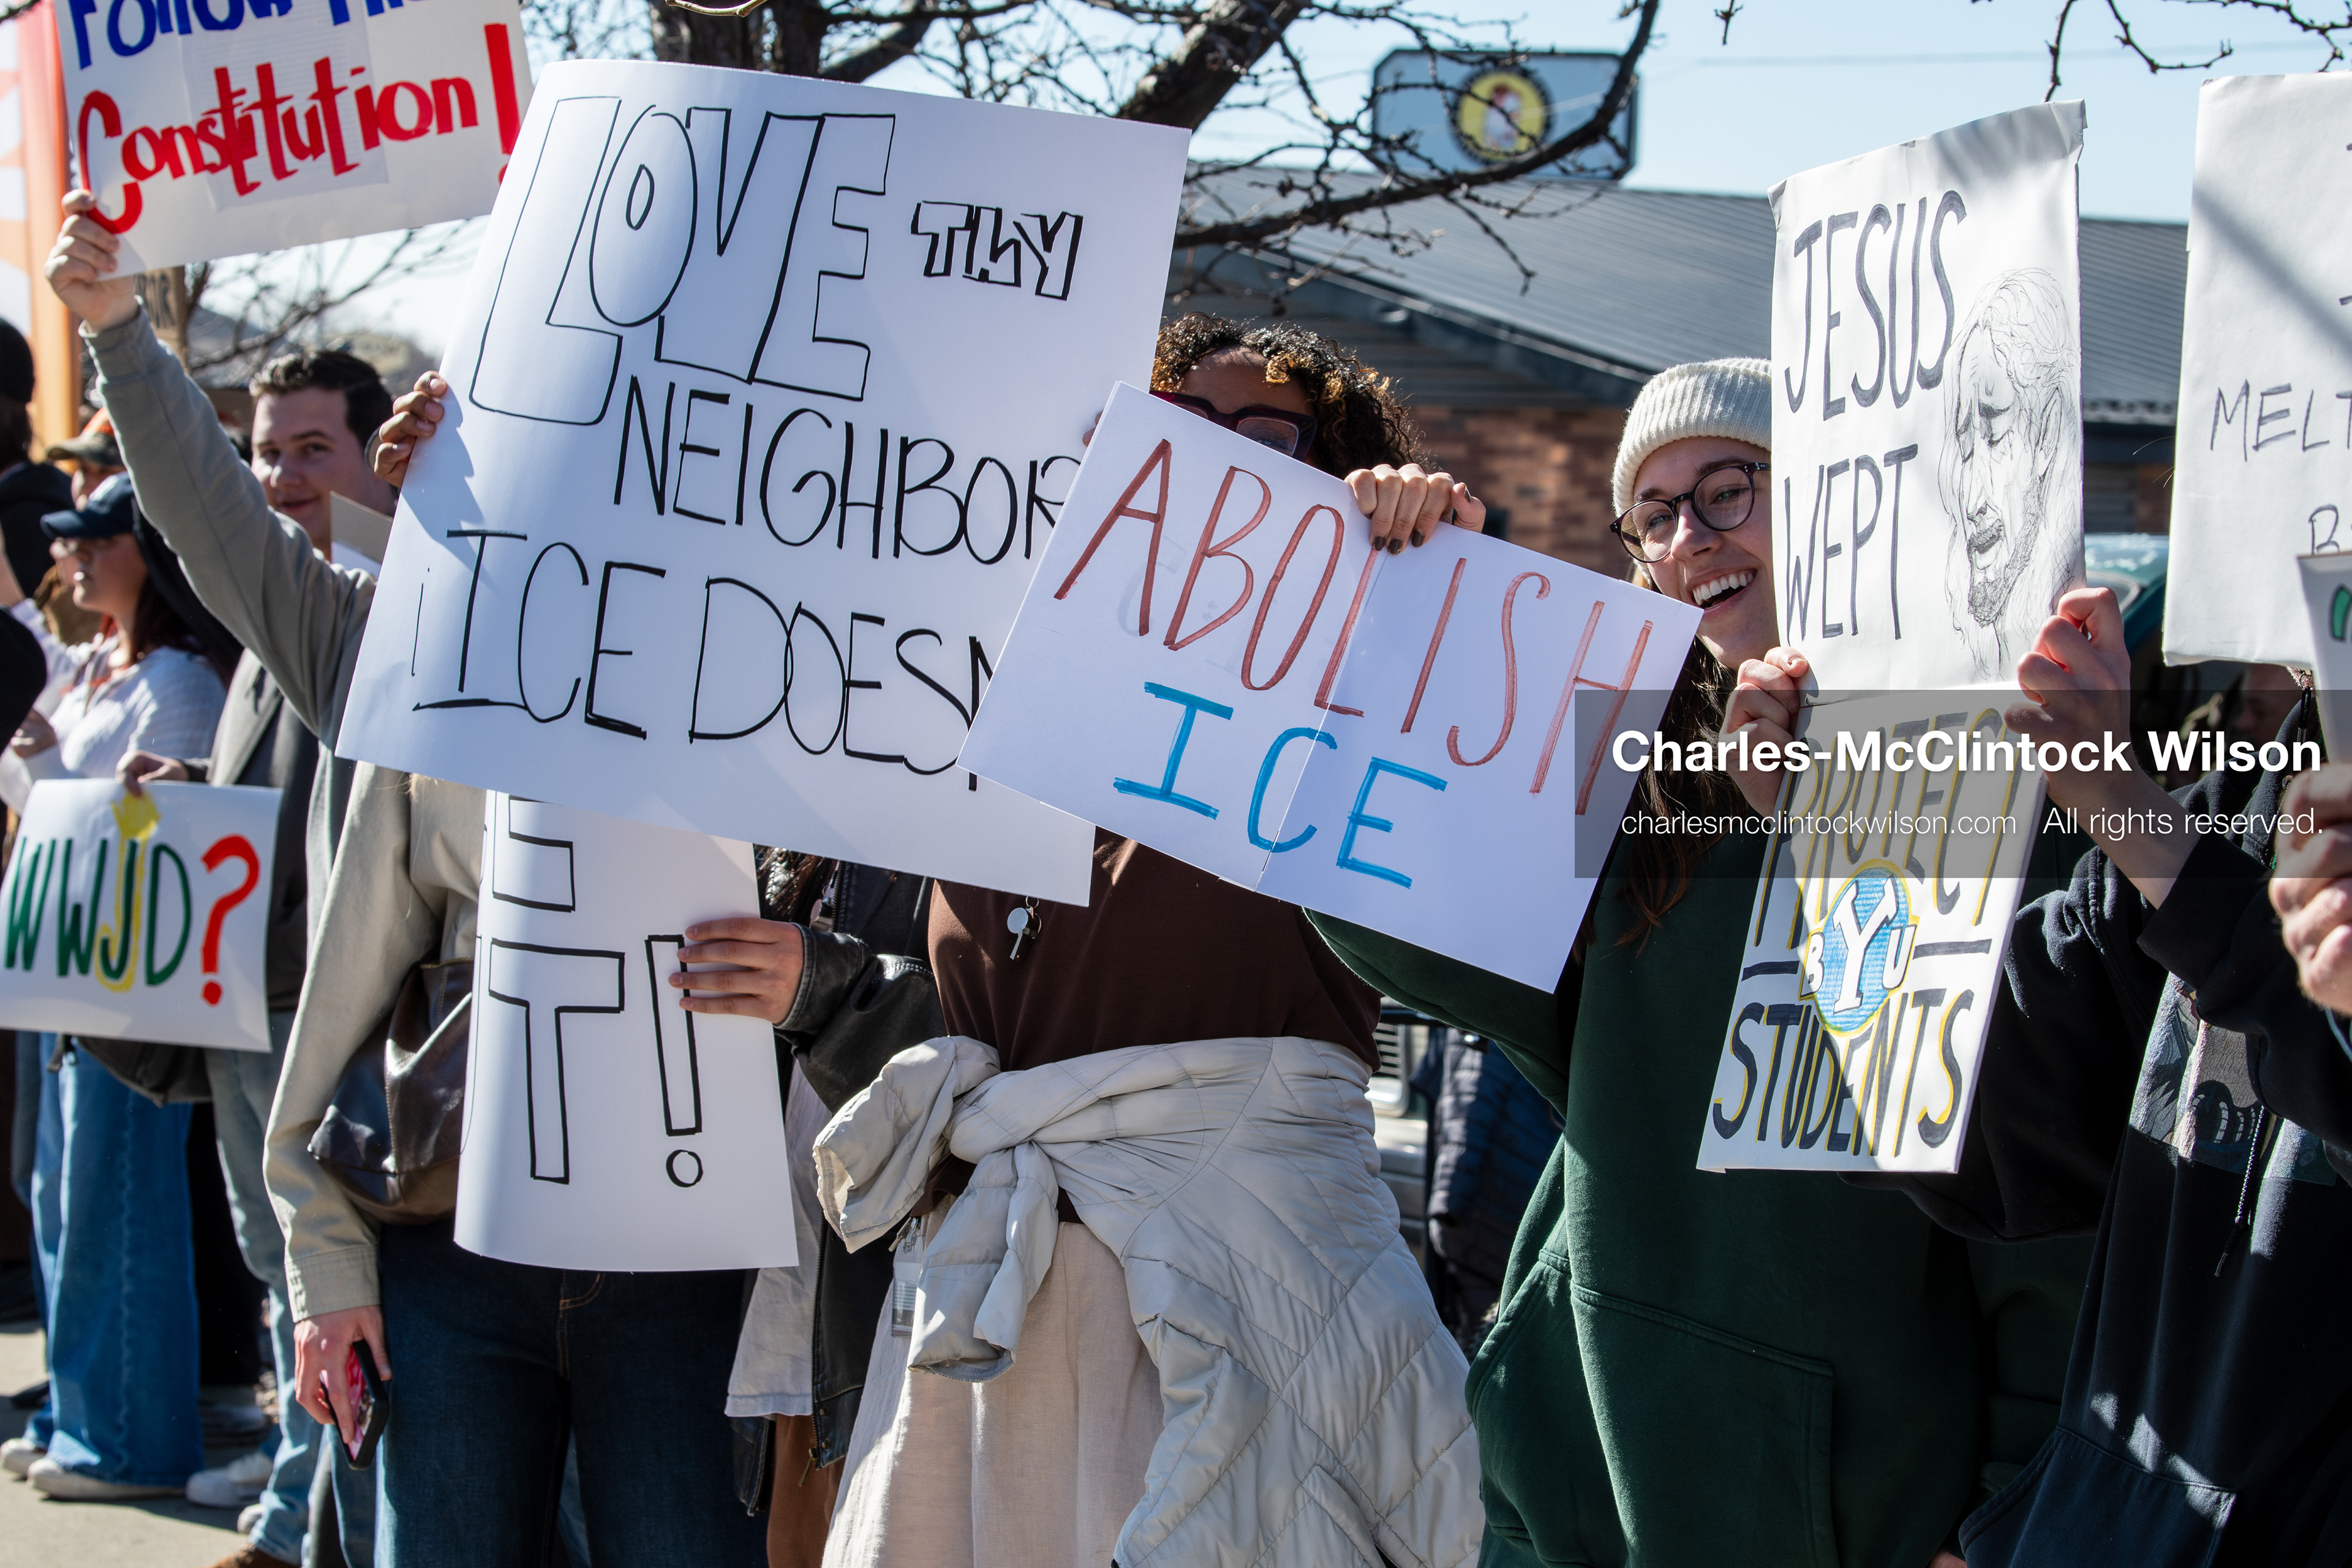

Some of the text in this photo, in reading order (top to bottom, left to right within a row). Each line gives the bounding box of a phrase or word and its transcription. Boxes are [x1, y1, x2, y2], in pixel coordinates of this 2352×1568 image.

[78, 23, 521, 234] Constitution!
[469, 96, 895, 425] LOVE
[1784, 190, 1967, 421] JESUS
[614, 375, 1082, 564] NEIGHBOR
[1784, 443, 1919, 647] WEPT
[412, 529, 666, 741] ICE
[1054, 438, 1653, 816] ABOLISH
[1112, 681, 1449, 890] ICE
[1754, 707, 2026, 950] PROTECT
[4, 833, 262, 1006] WWJD?
[1801, 874, 1917, 1015] BYU
[1713, 988, 1975, 1158] STUDENTS
